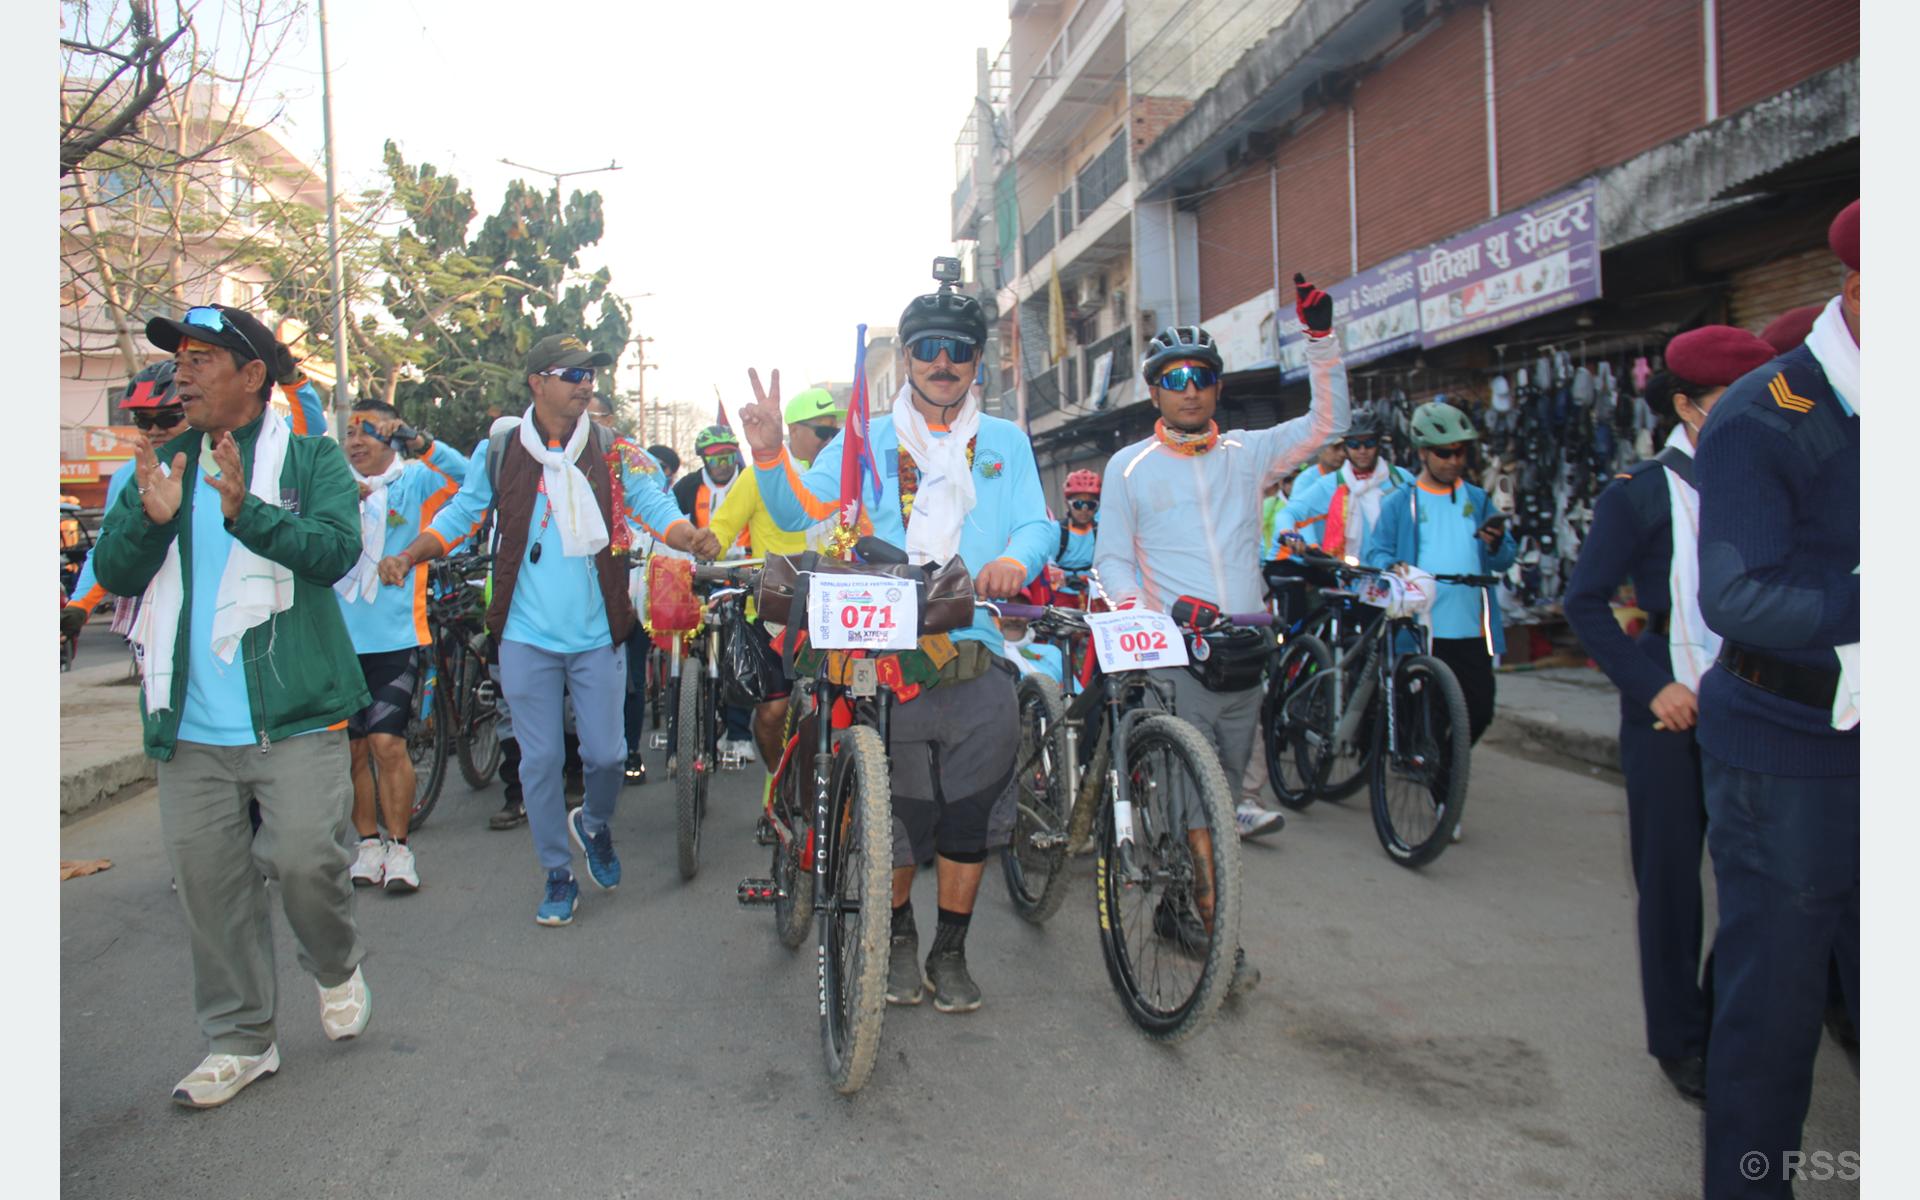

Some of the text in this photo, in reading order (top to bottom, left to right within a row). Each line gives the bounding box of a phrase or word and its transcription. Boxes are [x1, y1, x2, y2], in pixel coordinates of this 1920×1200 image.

[1485, 231, 1511, 269] शु
[1514, 196, 1593, 255] सेन्टर
[1360, 270, 1414, 307] Suppliers
[60, 464, 91, 475] ATM
[841, 605, 896, 629] 071
[1119, 631, 1168, 652] 002
[817, 775, 830, 874] MANITOU
